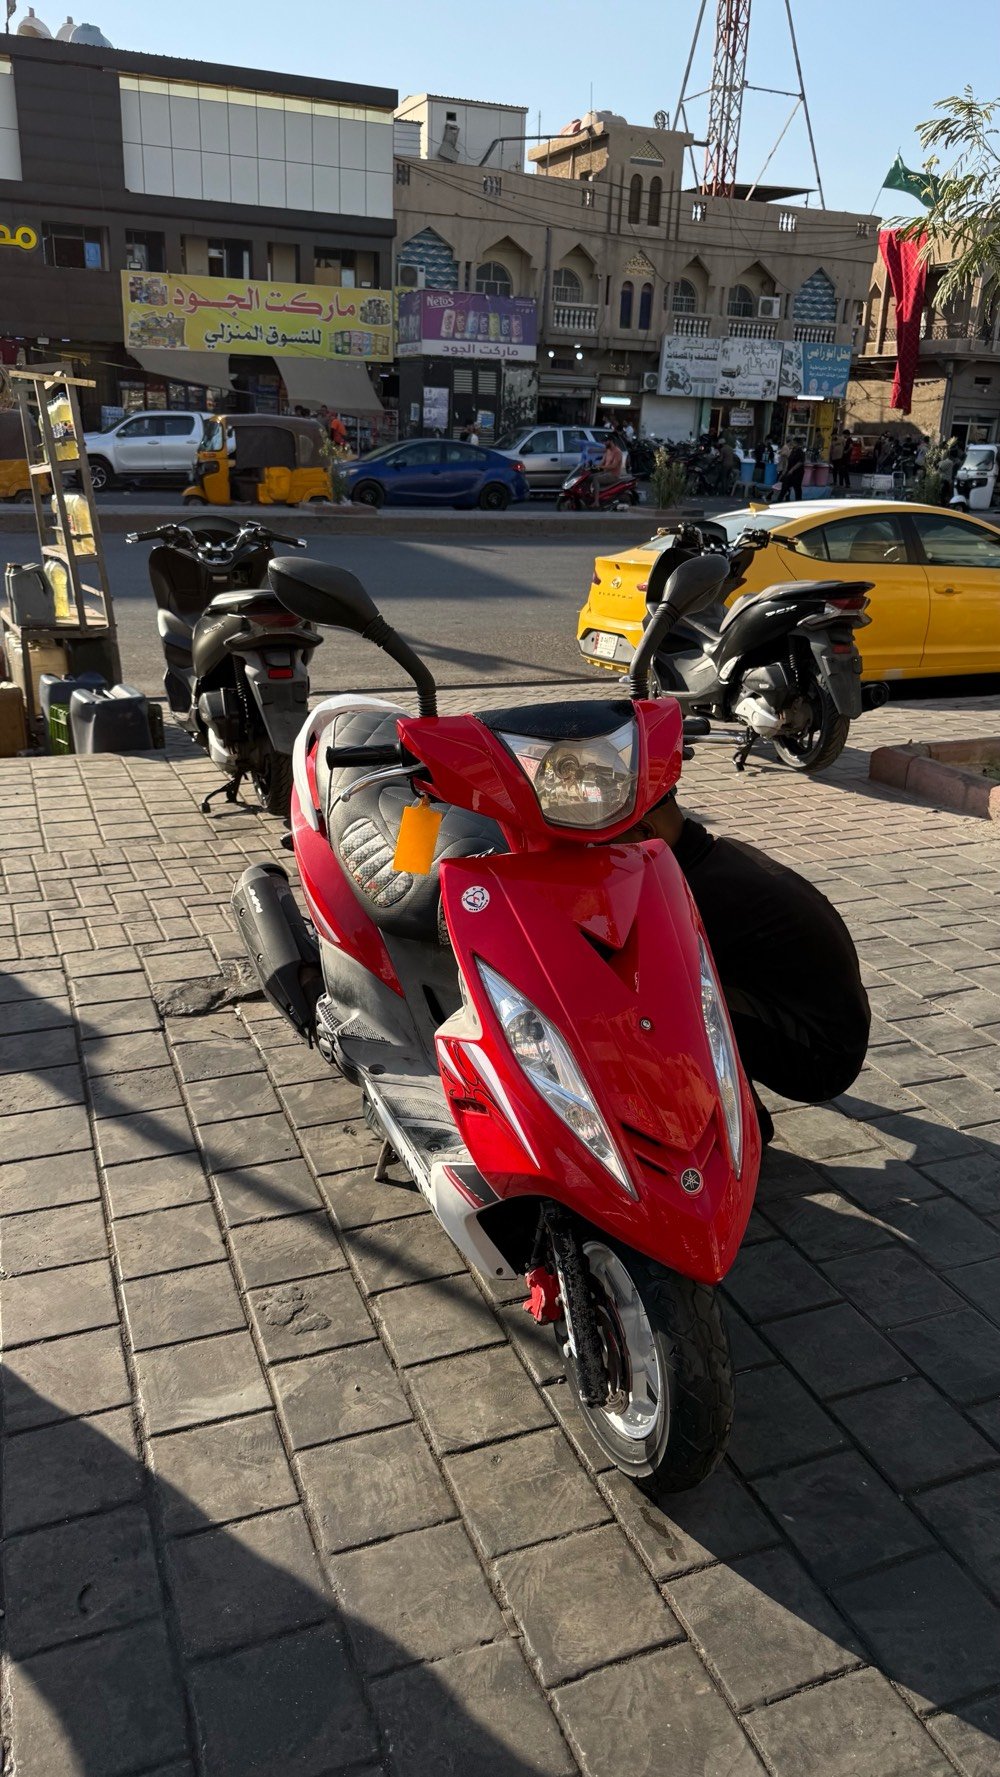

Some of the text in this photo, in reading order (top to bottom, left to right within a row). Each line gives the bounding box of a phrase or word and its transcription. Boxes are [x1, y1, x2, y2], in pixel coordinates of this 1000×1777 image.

[264, 291, 357, 322] ماركت
[203, 322, 322, 350] للتسوق المنزلي
[442, 344, 519, 357] ماركت الجود
